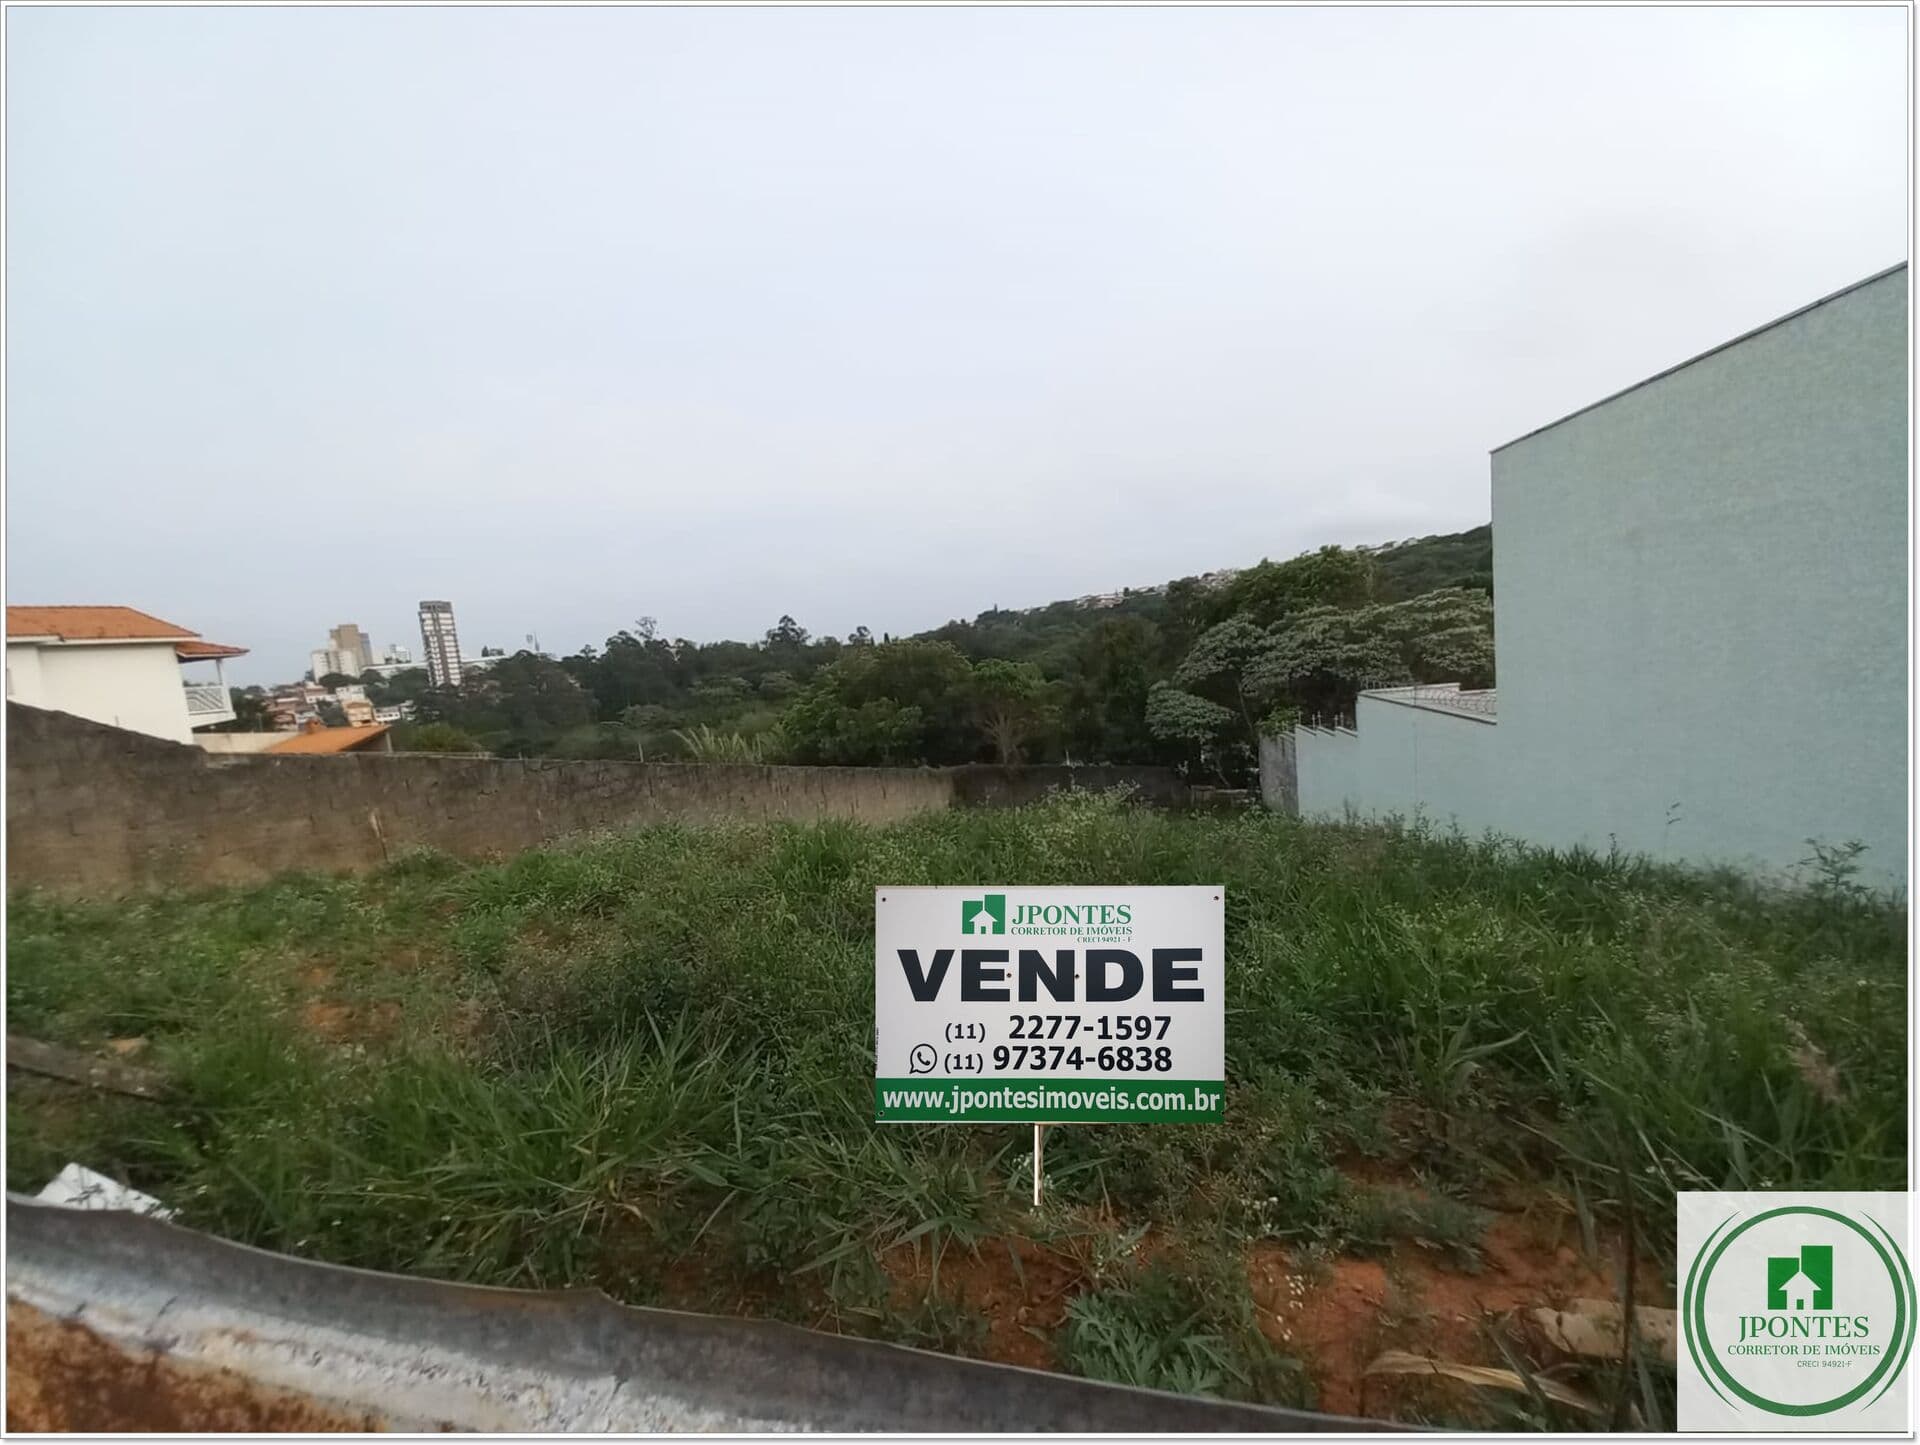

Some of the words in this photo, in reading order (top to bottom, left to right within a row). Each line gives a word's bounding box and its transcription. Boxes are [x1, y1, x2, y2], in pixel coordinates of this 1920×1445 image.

[1012, 904, 1132, 925] JPONTES
[1011, 926, 1067, 936] CORRETOR
[1070, 927, 1084, 936] DE
[1087, 925, 1133, 936] IMÓVEIS
[897, 948, 1205, 1002] VENDE
[945, 1022, 986, 1043] (11)
[1009, 1015, 1172, 1040] 2277-1597
[944, 1053, 983, 1074] (11)
[993, 1045, 1173, 1072] 97374-6838
[882, 1085, 1220, 1114] www.jpontesimoveis.com.br
